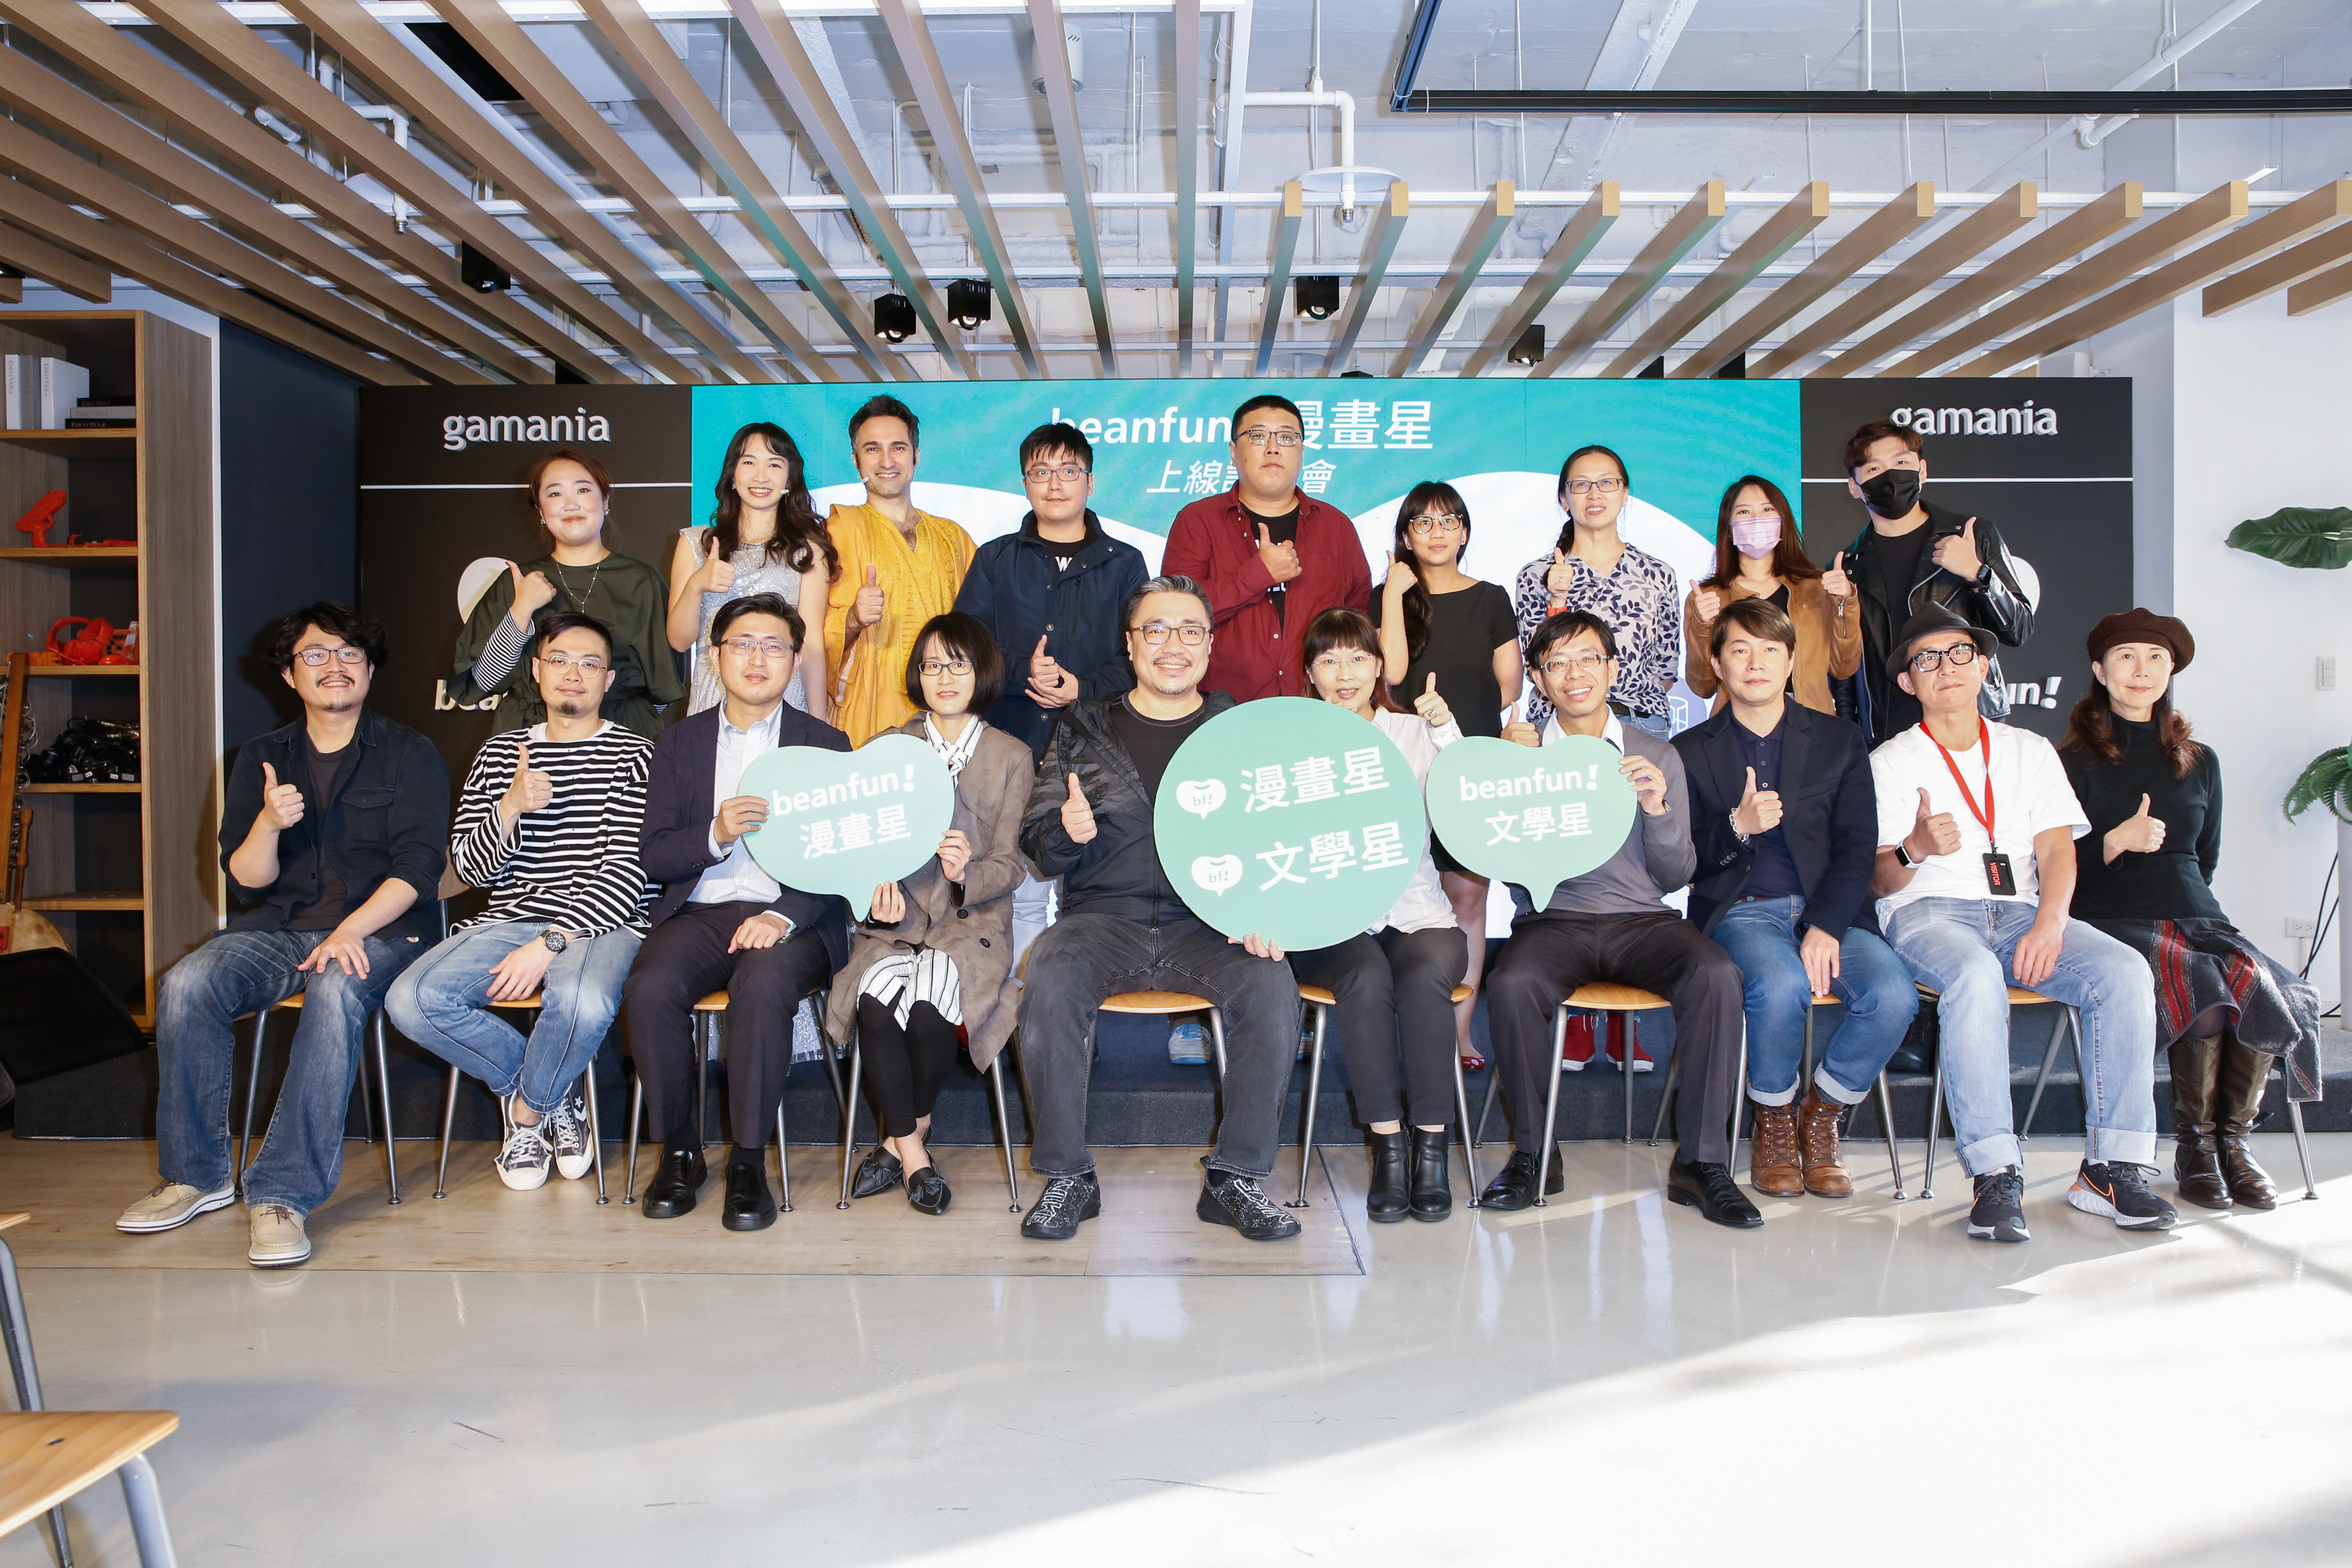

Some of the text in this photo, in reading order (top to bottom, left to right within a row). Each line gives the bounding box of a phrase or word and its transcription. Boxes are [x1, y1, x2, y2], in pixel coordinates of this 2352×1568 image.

[443, 407, 611, 451] gamania
[772, 764, 915, 817] beanfun!
[1193, 746, 1390, 813] bf! 漫畫星
[1459, 764, 1598, 802] beanfun!
[800, 804, 911, 859] 漫畫星
[1484, 802, 1592, 846] 文學星
[1208, 821, 1409, 891] bf! 文學星
[1989, 862, 2001, 886] VISITOR
